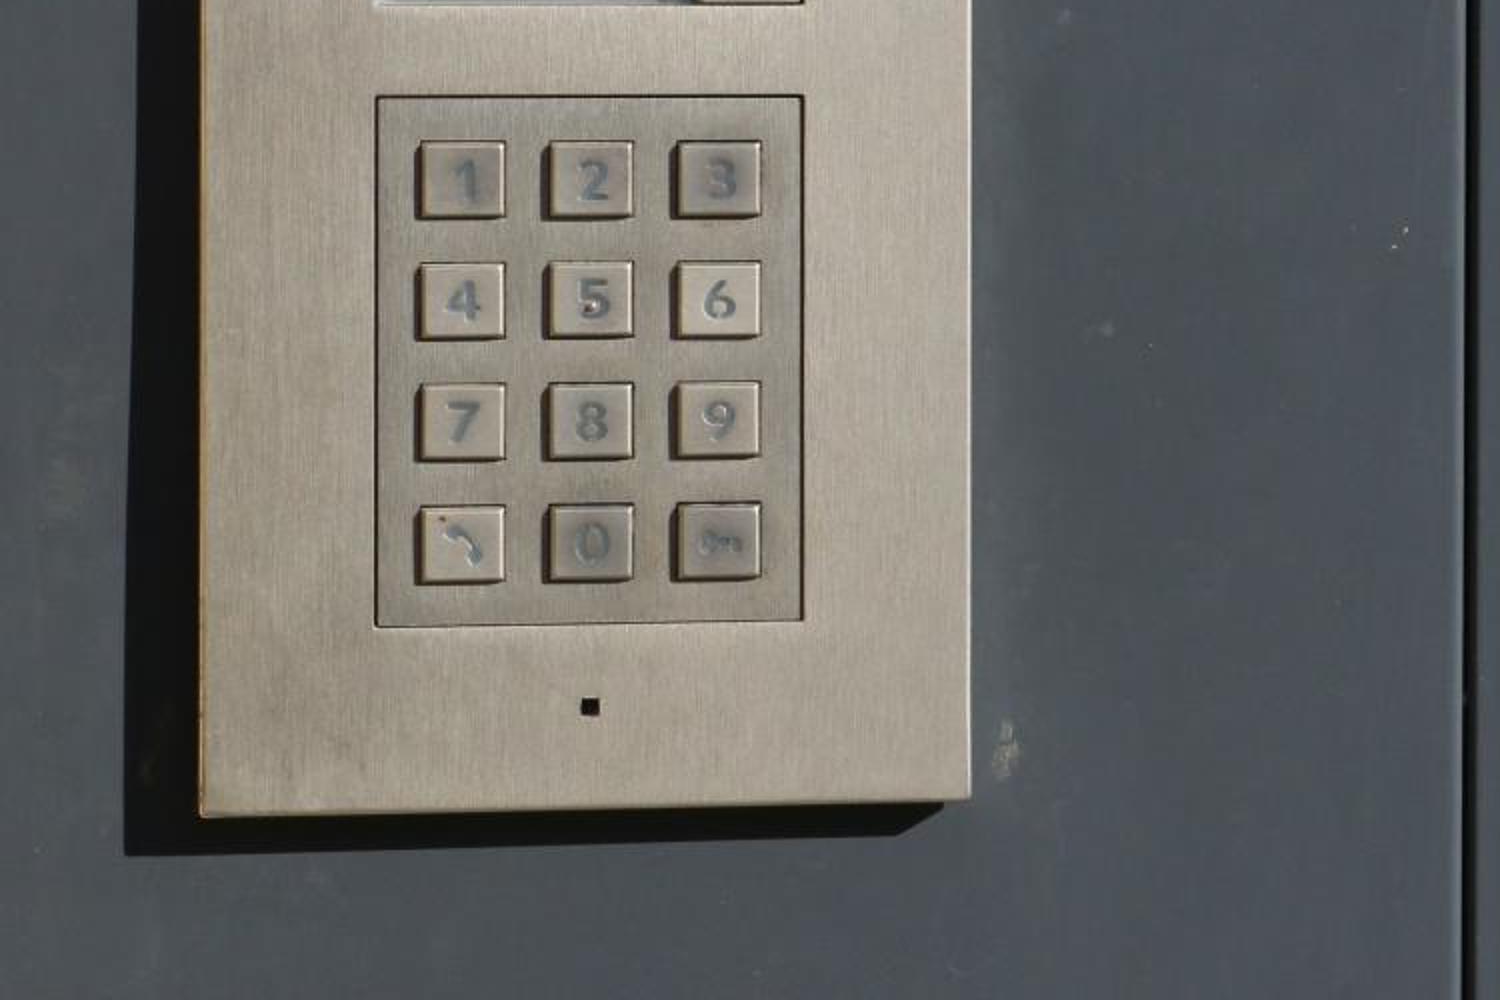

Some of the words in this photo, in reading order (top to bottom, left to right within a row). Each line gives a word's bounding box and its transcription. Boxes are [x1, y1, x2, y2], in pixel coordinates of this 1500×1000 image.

[453, 158, 480, 203] 1
[577, 159, 609, 201] 2
[706, 156, 737, 200] 3
[444, 279, 482, 322] 4
[577, 278, 610, 319] 5
[703, 279, 737, 319] 6
[446, 400, 480, 445] 7
[576, 401, 608, 442] 8
[703, 399, 736, 441] 9
[575, 521, 610, 567] 0
